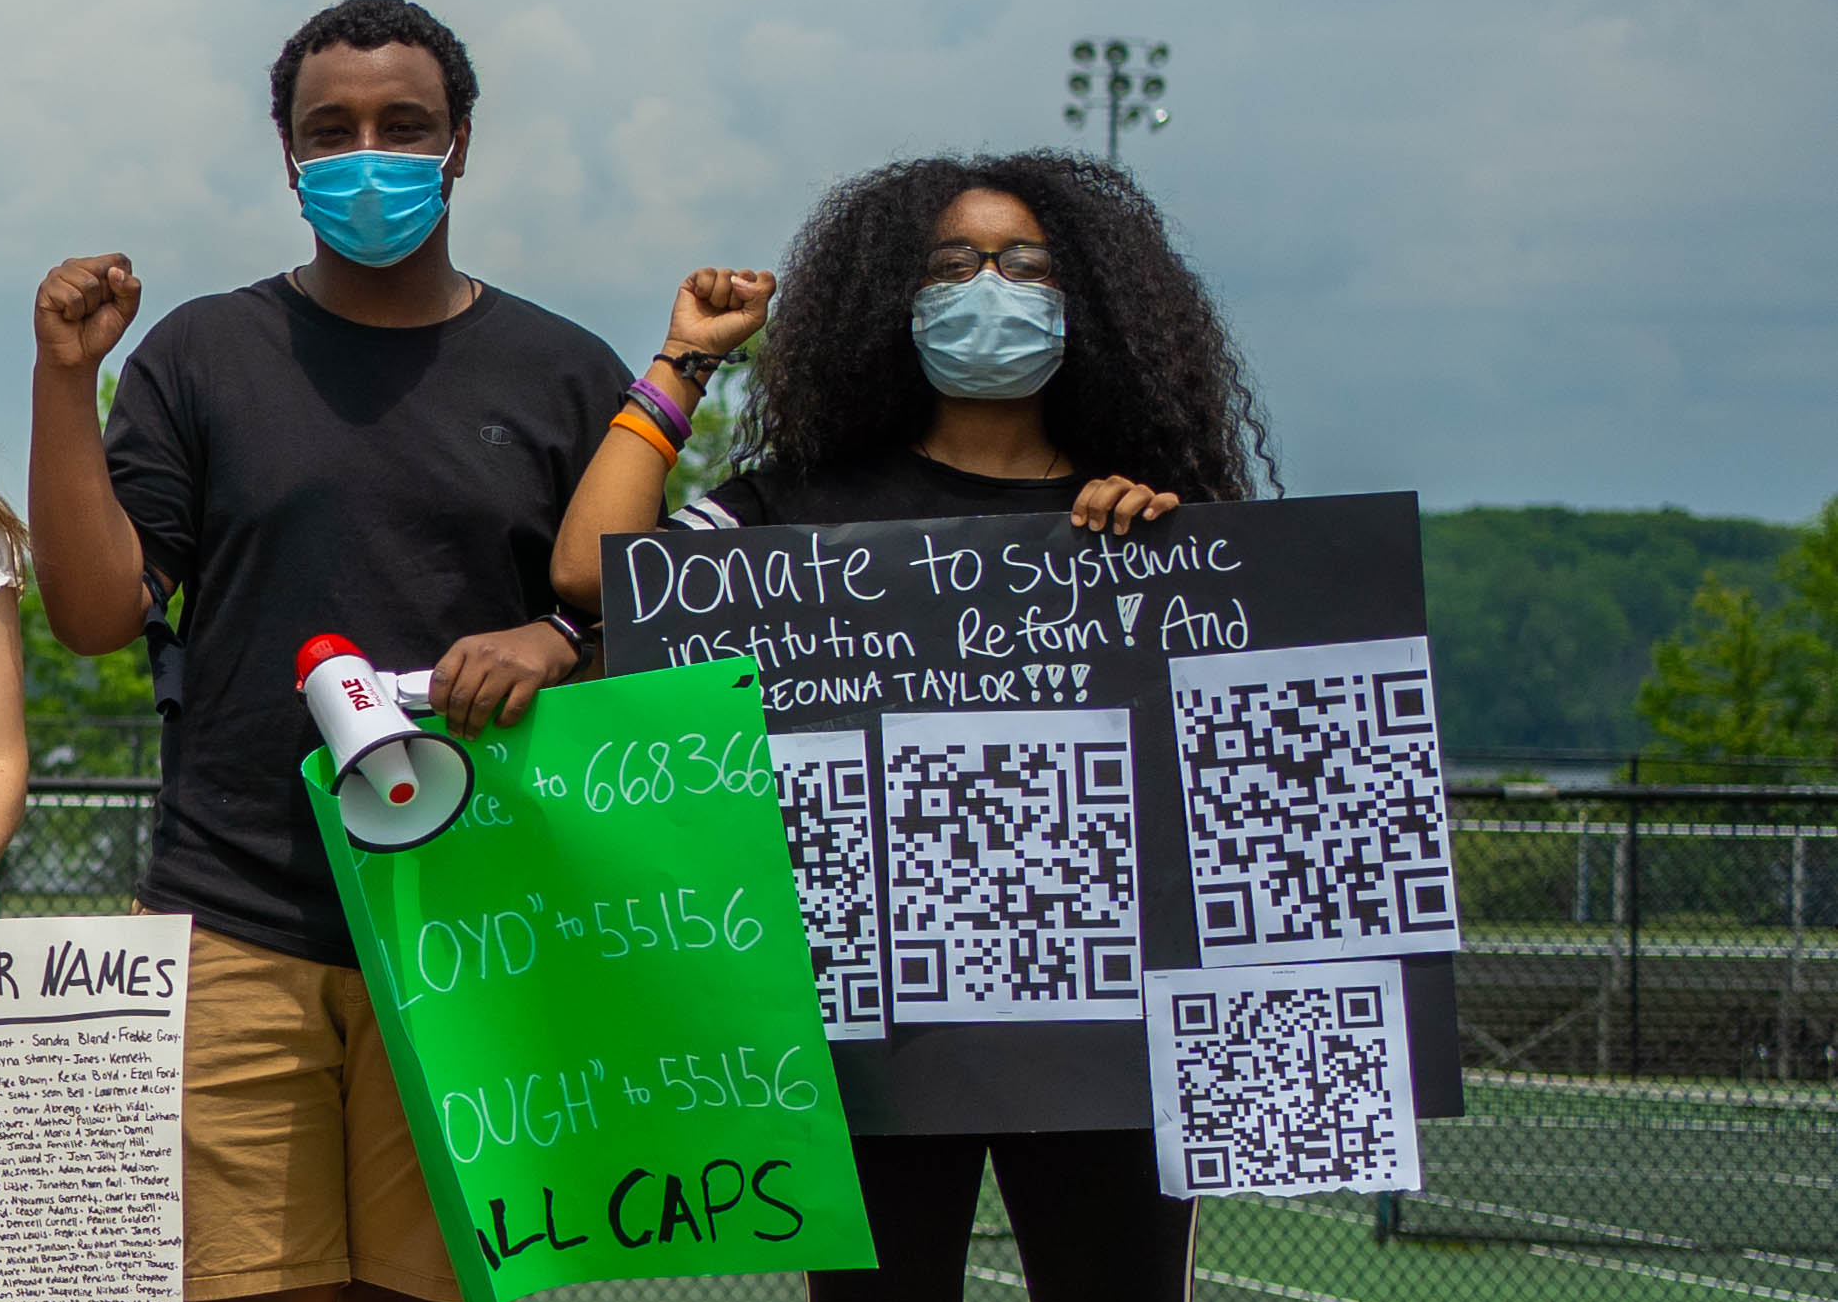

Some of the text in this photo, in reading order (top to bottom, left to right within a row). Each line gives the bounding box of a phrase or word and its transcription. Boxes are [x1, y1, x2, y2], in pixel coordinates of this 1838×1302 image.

[626, 532, 886, 624] Donate
[909, 532, 983, 595] to
[661, 616, 915, 671] institution
[1161, 595, 1249, 651] And
[341, 678, 374, 711] PYLE
[893, 664, 1091, 706] TAYLOR!!!
[532, 767, 567, 797] to
[584, 732, 772, 813] 668366
[556, 912, 584, 940] to
[595, 888, 763, 958] 55156
[41, 940, 175, 999] NAMES
[32, 1034, 69, 1047] Sandra
[78, 1031, 109, 1045] Bland
[157, 1029, 179, 1043] Gray
[109, 1052, 152, 1064] Kenneth
[624, 1077, 650, 1105] to
[660, 1046, 819, 1111] 55156
[608, 1159, 803, 1248] CAPS
